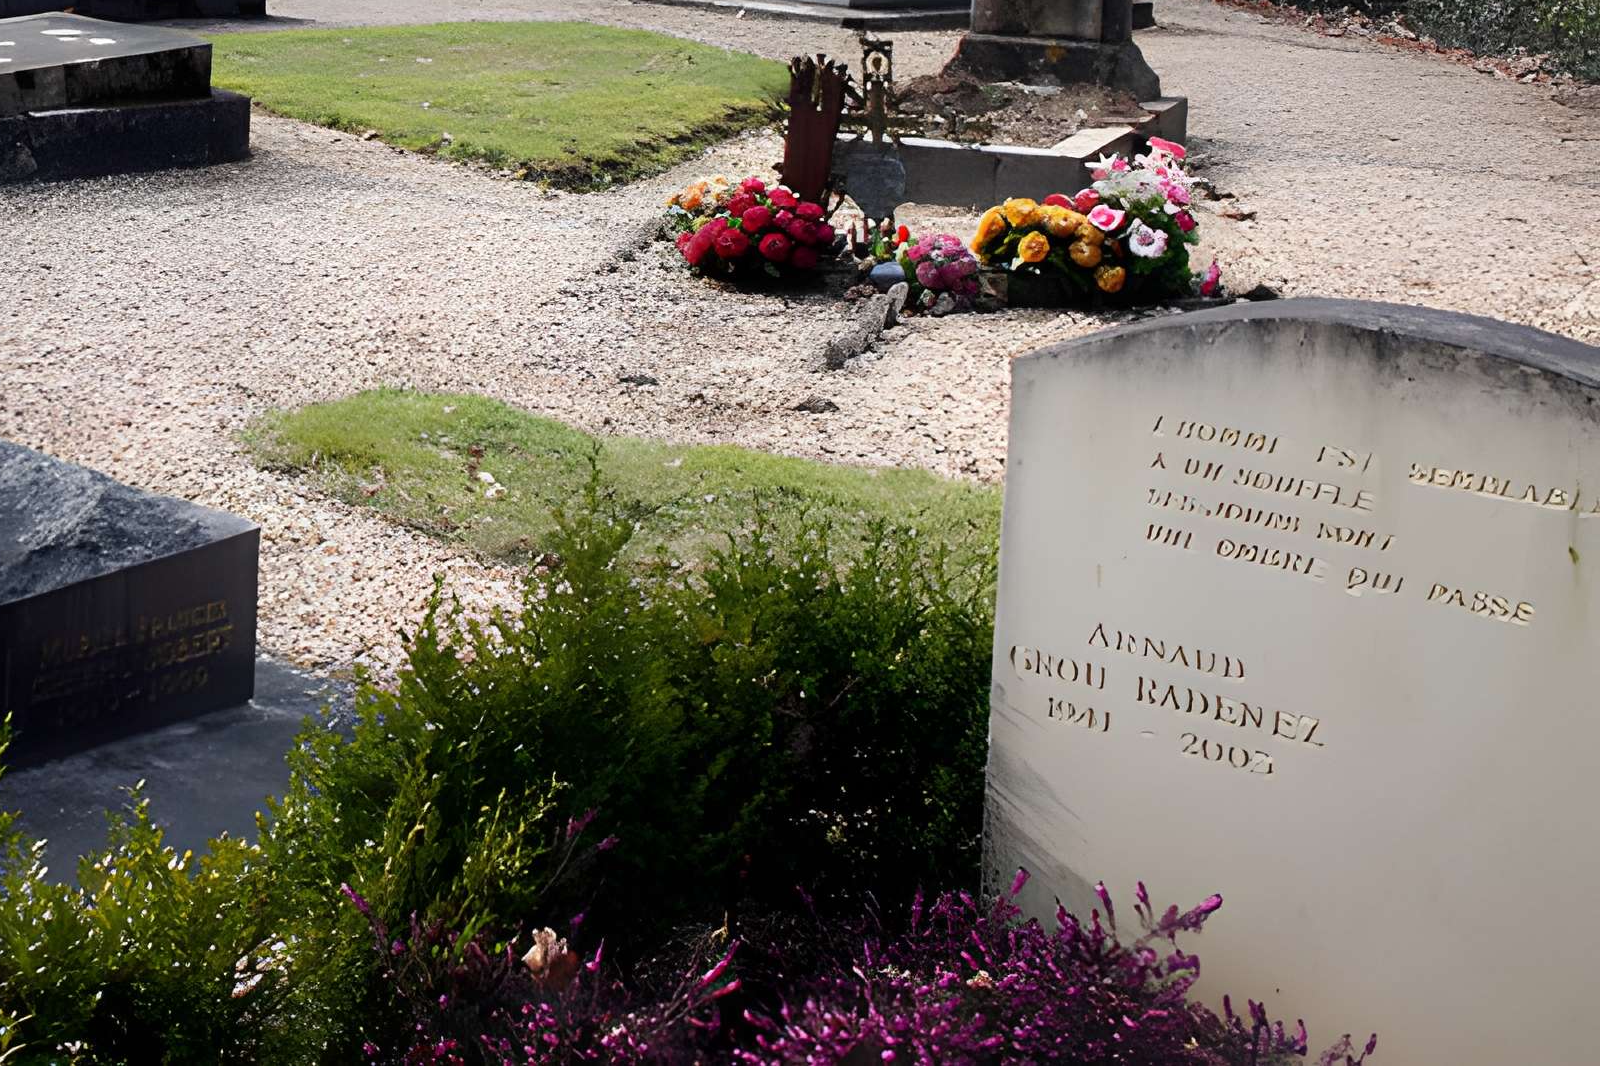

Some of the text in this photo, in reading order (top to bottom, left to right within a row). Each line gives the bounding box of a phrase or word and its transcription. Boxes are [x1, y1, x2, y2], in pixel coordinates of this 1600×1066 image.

[1184, 457, 1224, 482] UN
[1232, 467, 1377, 513] SOUFFLE
[1216, 538, 1330, 580] OMBRE
[1347, 567, 1404, 597] QUI
[1427, 583, 1537, 625] PASSE
[1087, 621, 1247, 680] ARNAUD
[1135, 675, 1326, 747] RADENEZ
